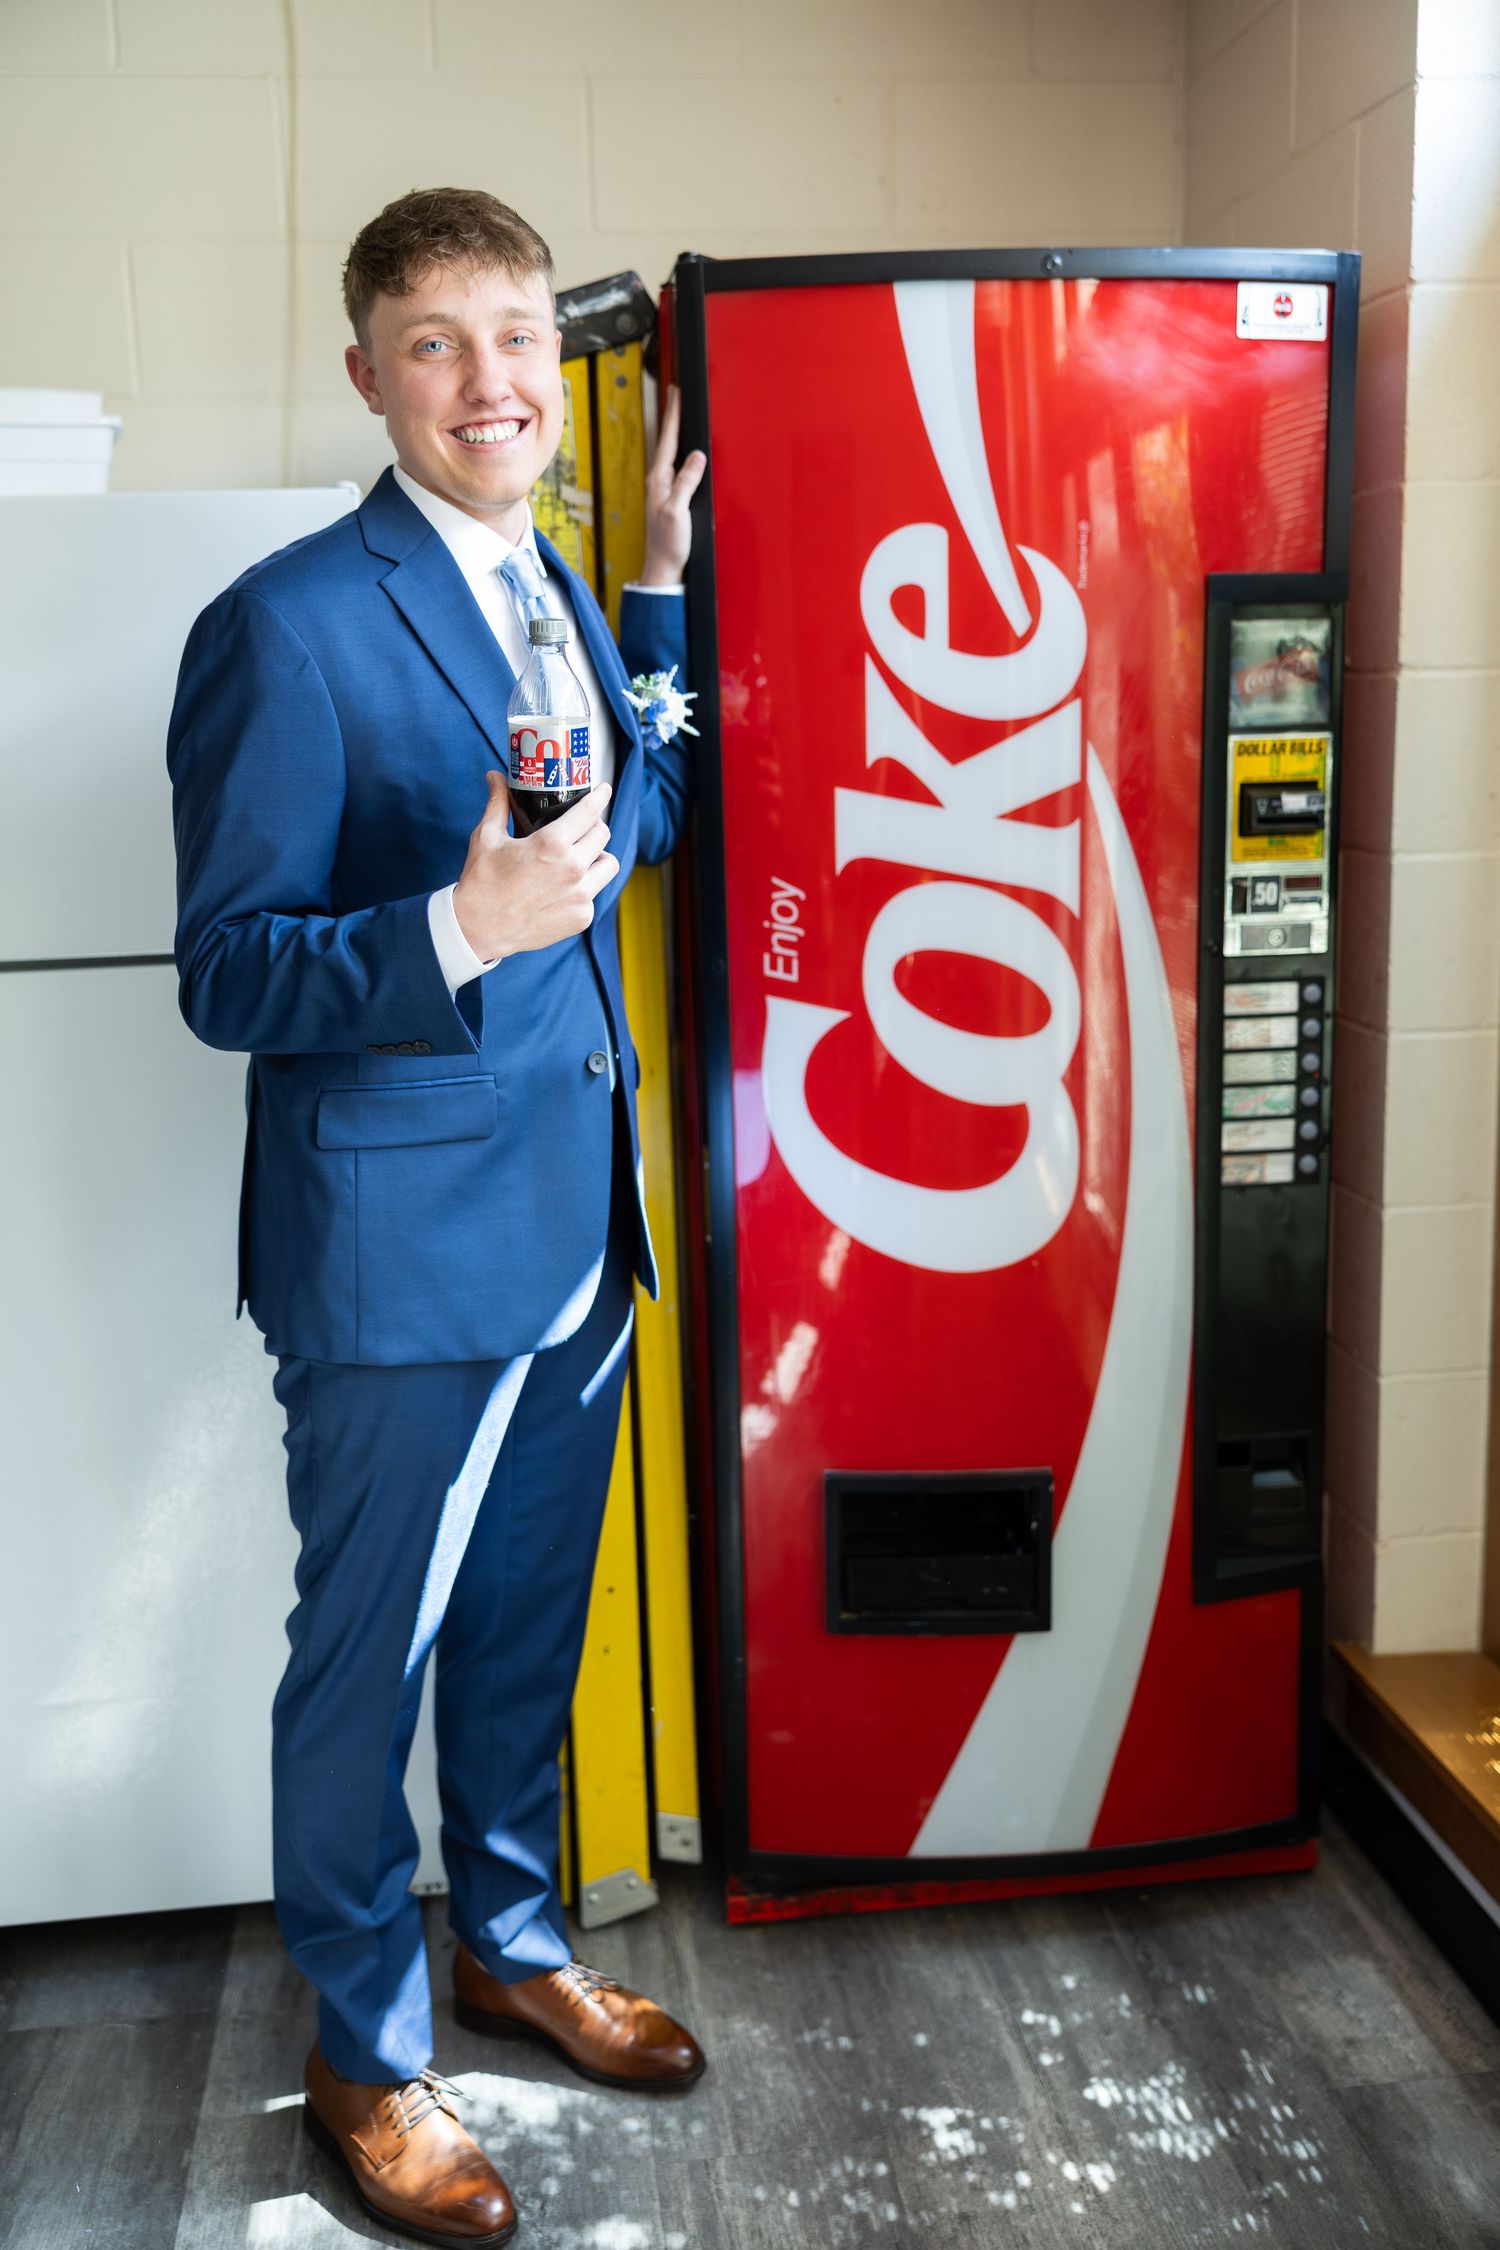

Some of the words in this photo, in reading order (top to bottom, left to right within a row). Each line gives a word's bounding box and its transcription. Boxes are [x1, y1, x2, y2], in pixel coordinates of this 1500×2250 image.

[1237, 741, 1286, 757] DOLLAR
[1289, 739, 1323, 755] BILLS
[762, 522, 1087, 1274] Coke
[1251, 881, 1278, 906] .50
[762, 875, 807, 983] Enjoy
